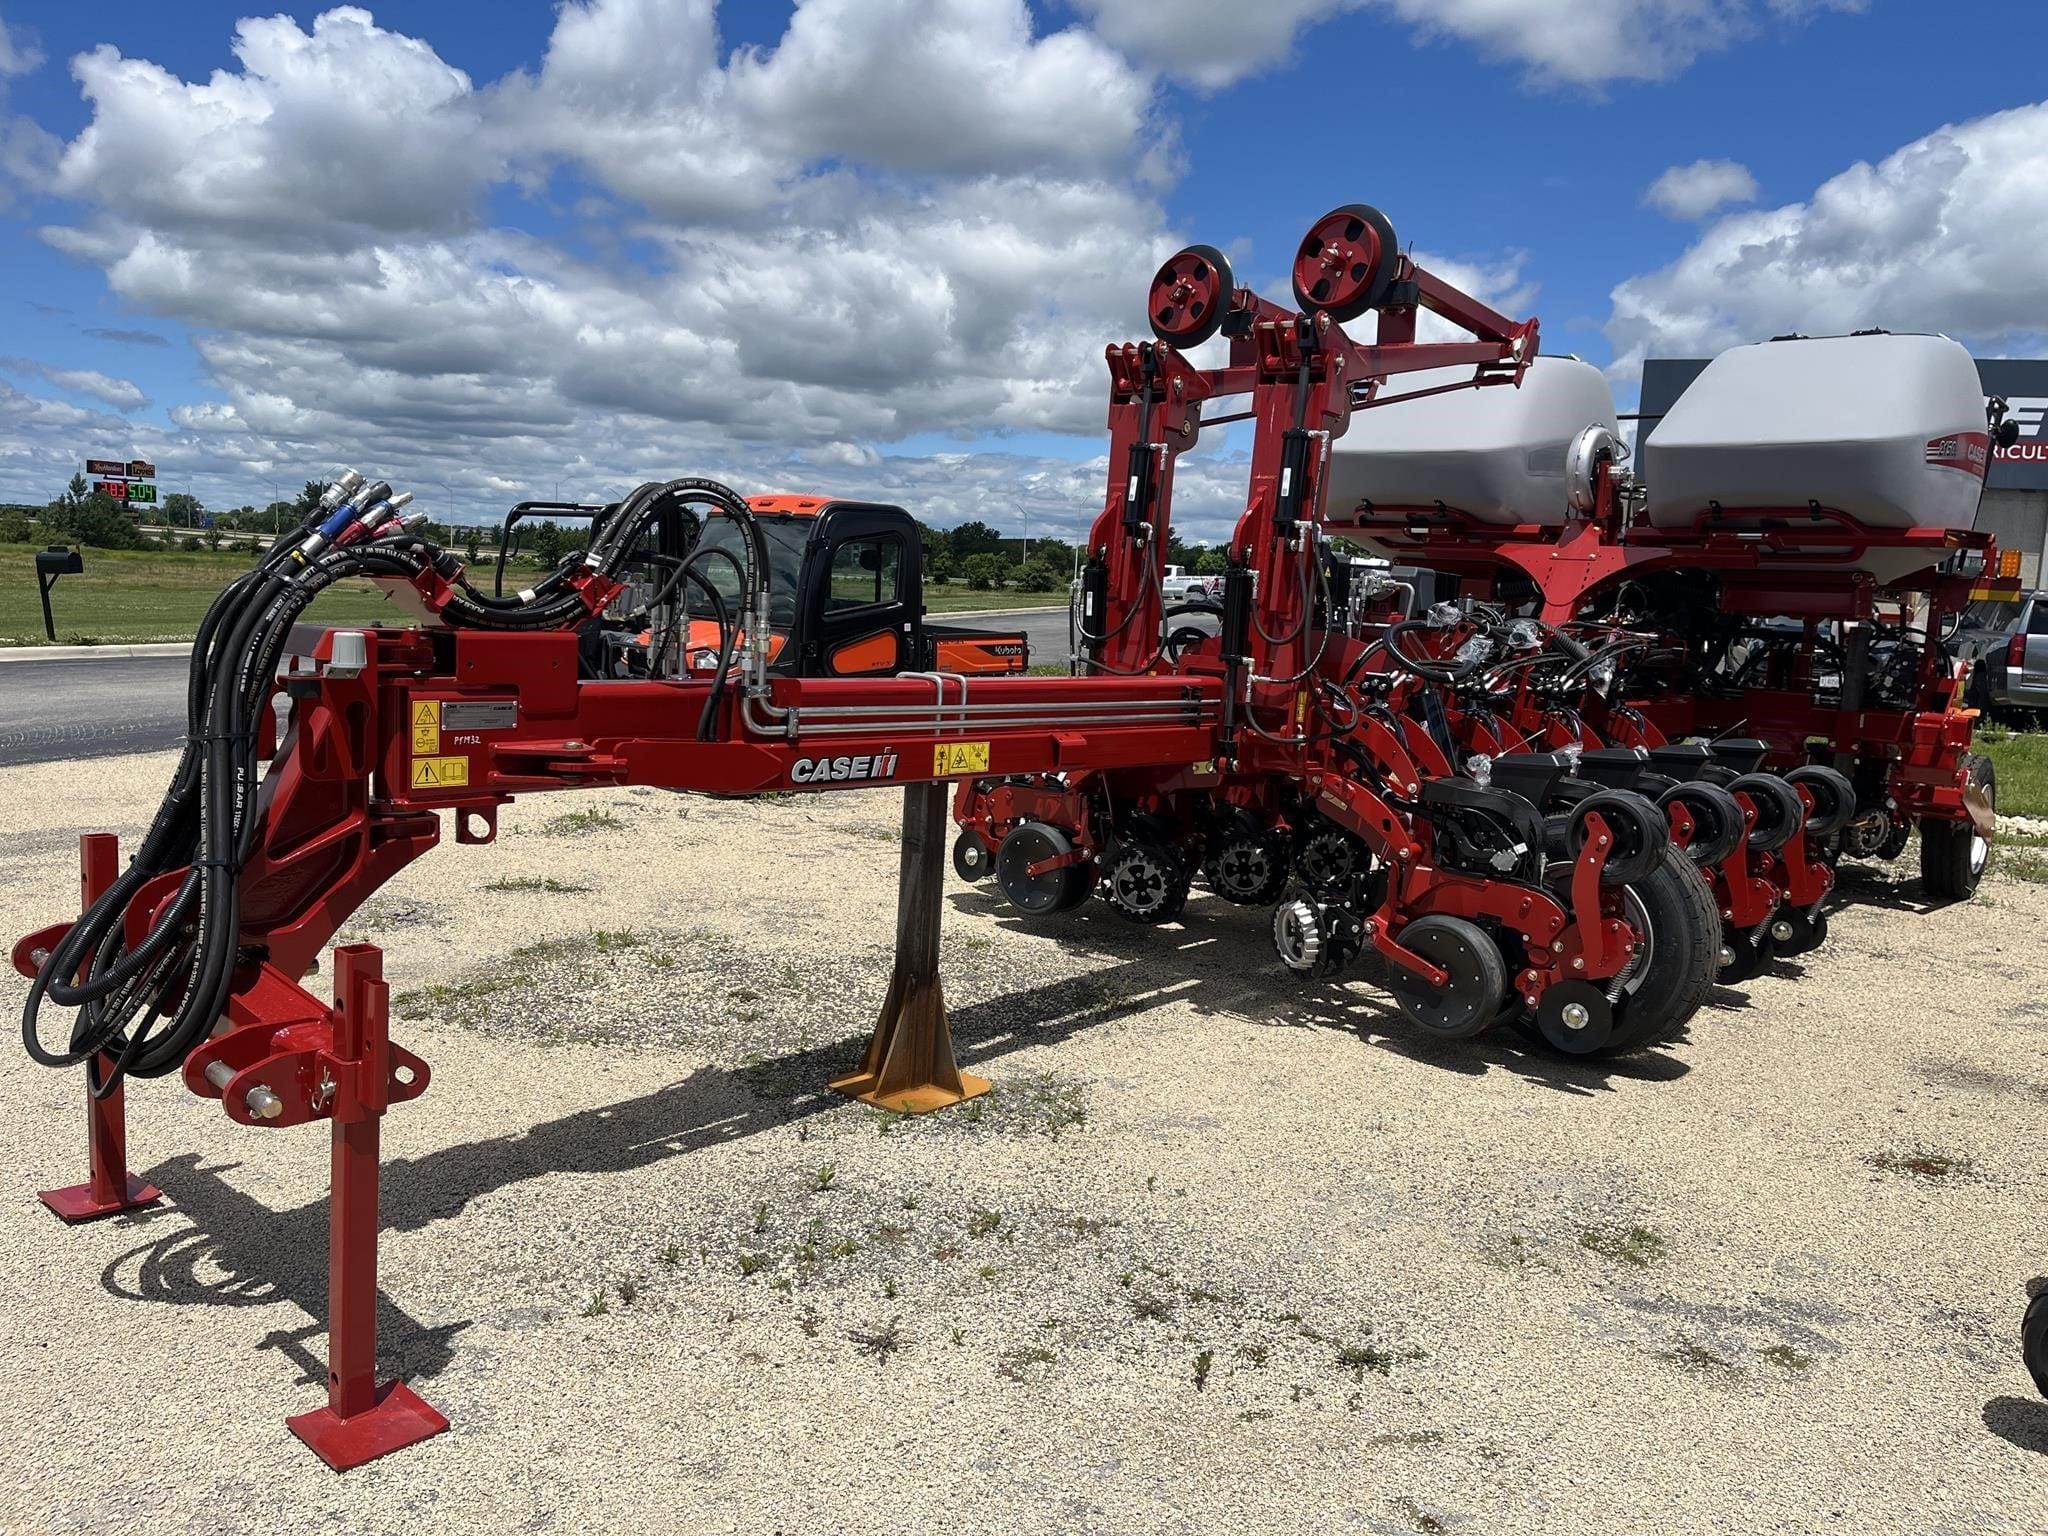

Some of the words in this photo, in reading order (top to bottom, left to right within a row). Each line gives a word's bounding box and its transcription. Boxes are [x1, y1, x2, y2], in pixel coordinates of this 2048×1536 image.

[1993, 444, 2048, 460] RICUL
[995, 645, 1022, 655] Kubota
[792, 757, 871, 783] CASE
